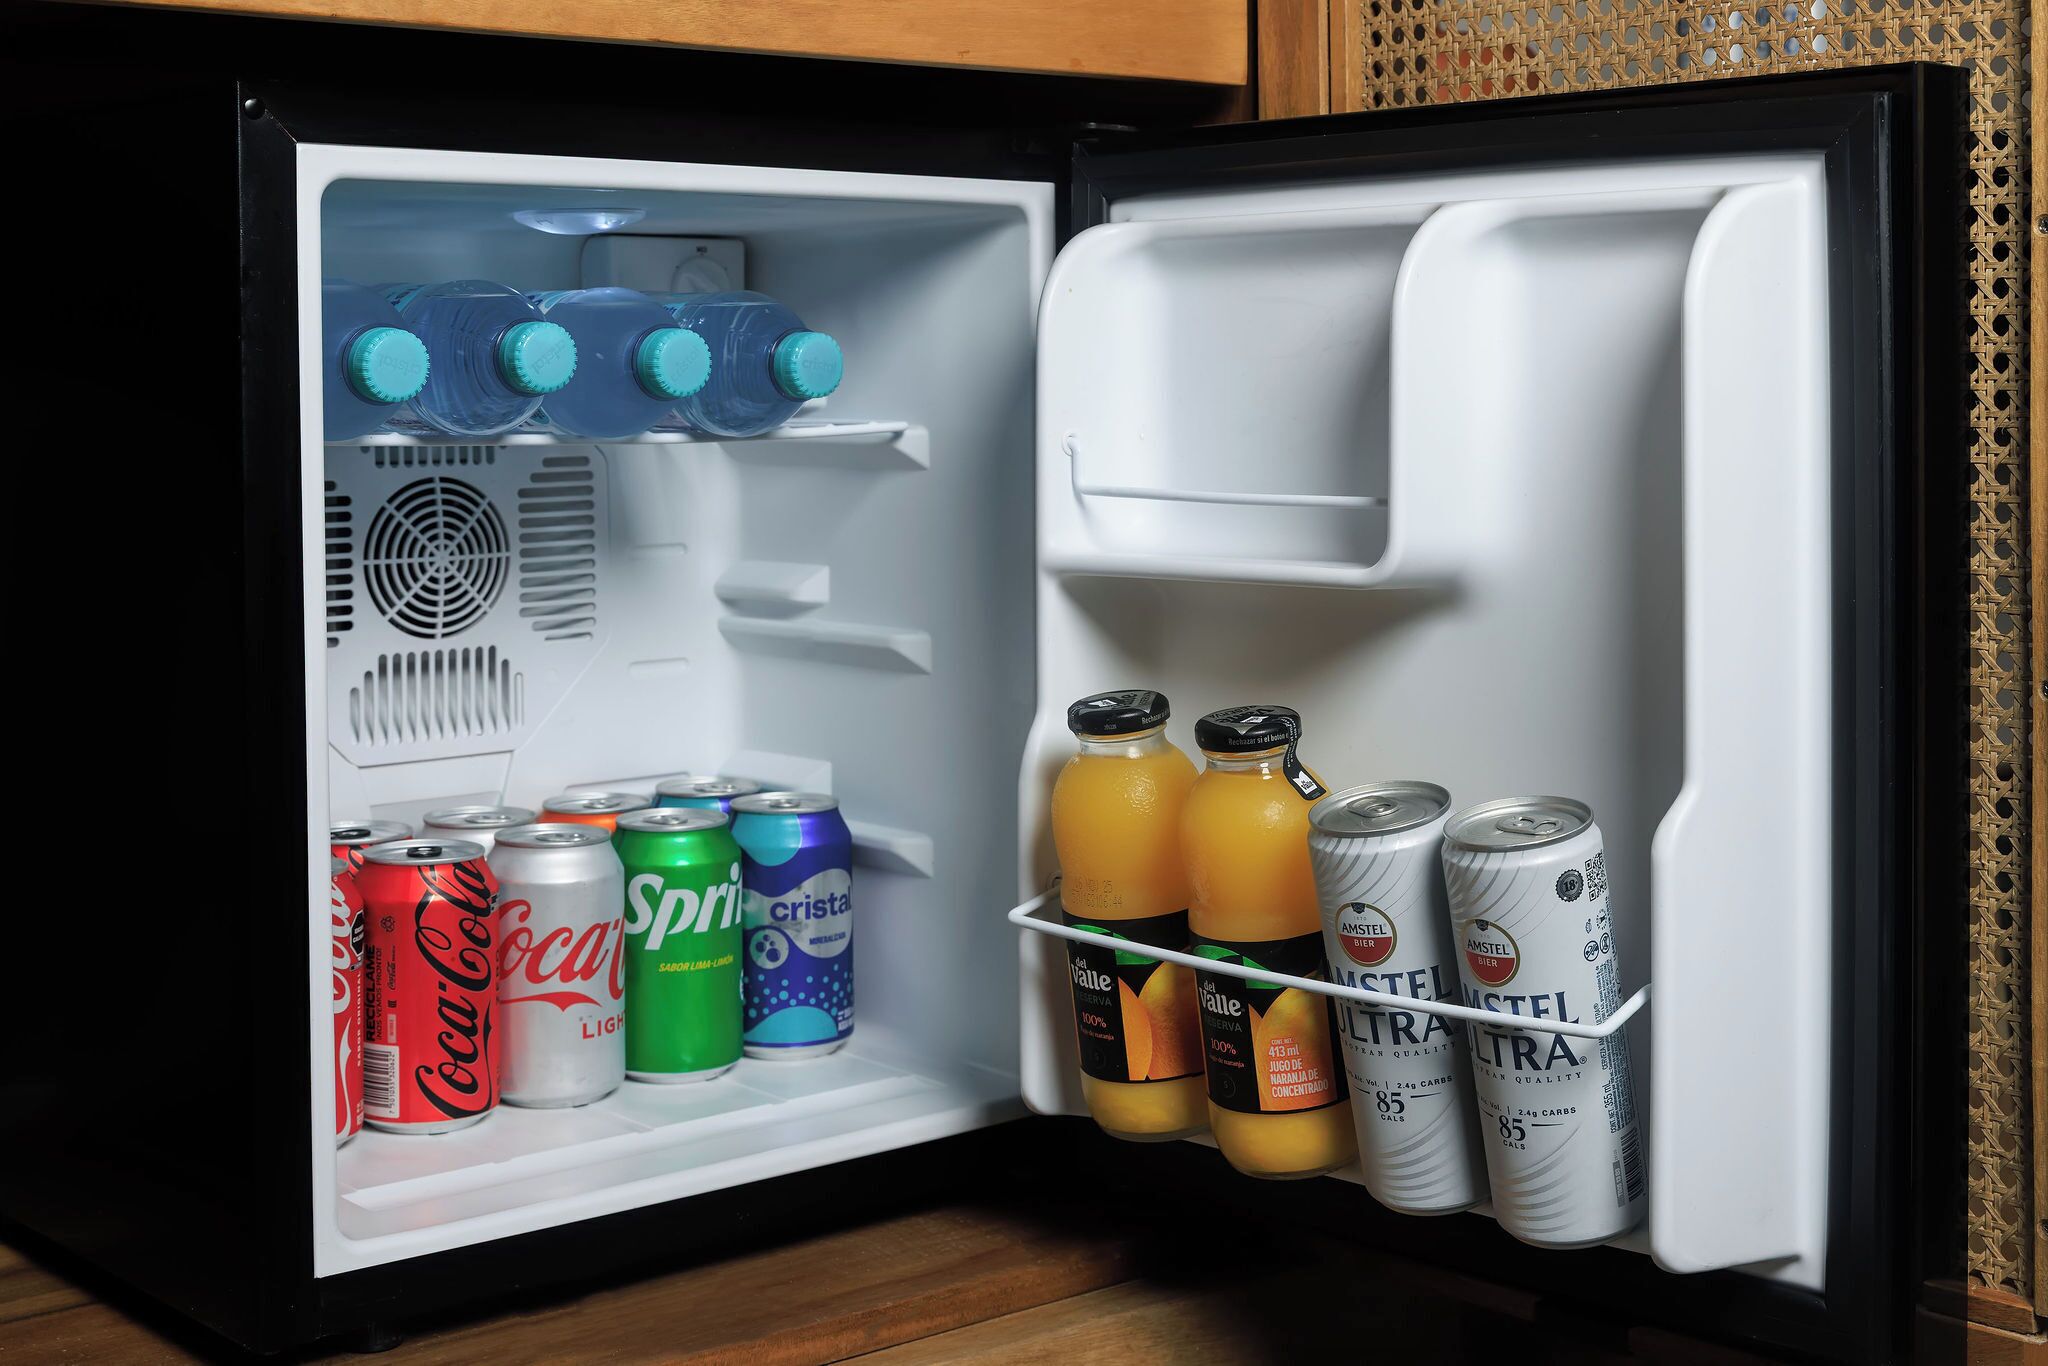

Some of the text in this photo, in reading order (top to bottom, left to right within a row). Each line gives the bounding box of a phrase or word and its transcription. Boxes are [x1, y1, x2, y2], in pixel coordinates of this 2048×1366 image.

[1228, 737, 1256, 746] Rechazar
[1257, 735, 1263, 744] si
[1264, 734, 1270, 743] el
[769, 885, 852, 922] cristal
[1342, 922, 1387, 936] AMSTEL
[1353, 938, 1375, 948] BIER
[1467, 938, 1510, 956] AMSTEL
[659, 963, 689, 973] SABOR
[1075, 956, 1087, 969] del
[1477, 956, 1498, 968] BIER
[1071, 963, 1112, 992] Valle
[1334, 964, 1454, 1007] MSTEL
[415, 860, 492, 1120] Coca-Cola
[1203, 980, 1216, 993] del
[1078, 990, 1113, 1008] ESERVA
[1199, 986, 1242, 1017] Valle
[1463, 981, 1580, 1032] MSTEL
[582, 1011, 626, 1040] LIGH
[1082, 1011, 1107, 1028] 100%
[1205, 1014, 1243, 1033] ESERVA
[1210, 1037, 1236, 1055] 100%
[1269, 1044, 1300, 1057] 413 ml
[1393, 1041, 1456, 1058] QUALITY
[1269, 1058, 1303, 1072] JUGO DE
[1270, 1068, 1319, 1085] NARANJA DE
[1396, 1082, 1416, 1090] 2.4g
[1420, 1075, 1453, 1088] CARBS
[1515, 1072, 1582, 1085] QUALITY
[1271, 1078, 1329, 1098] CONCENTRADO
[1601, 1079, 1612, 1094] mL
[1376, 1090, 1405, 1114] 85
[1603, 1093, 1613, 1108] 355
[1380, 1114, 1405, 1122] CALS
[1518, 1109, 1538, 1118] 2.4g
[1541, 1106, 1577, 1117] CARBS
[1499, 1115, 1526, 1141] 85
[1503, 1139, 1526, 1150] CALS
